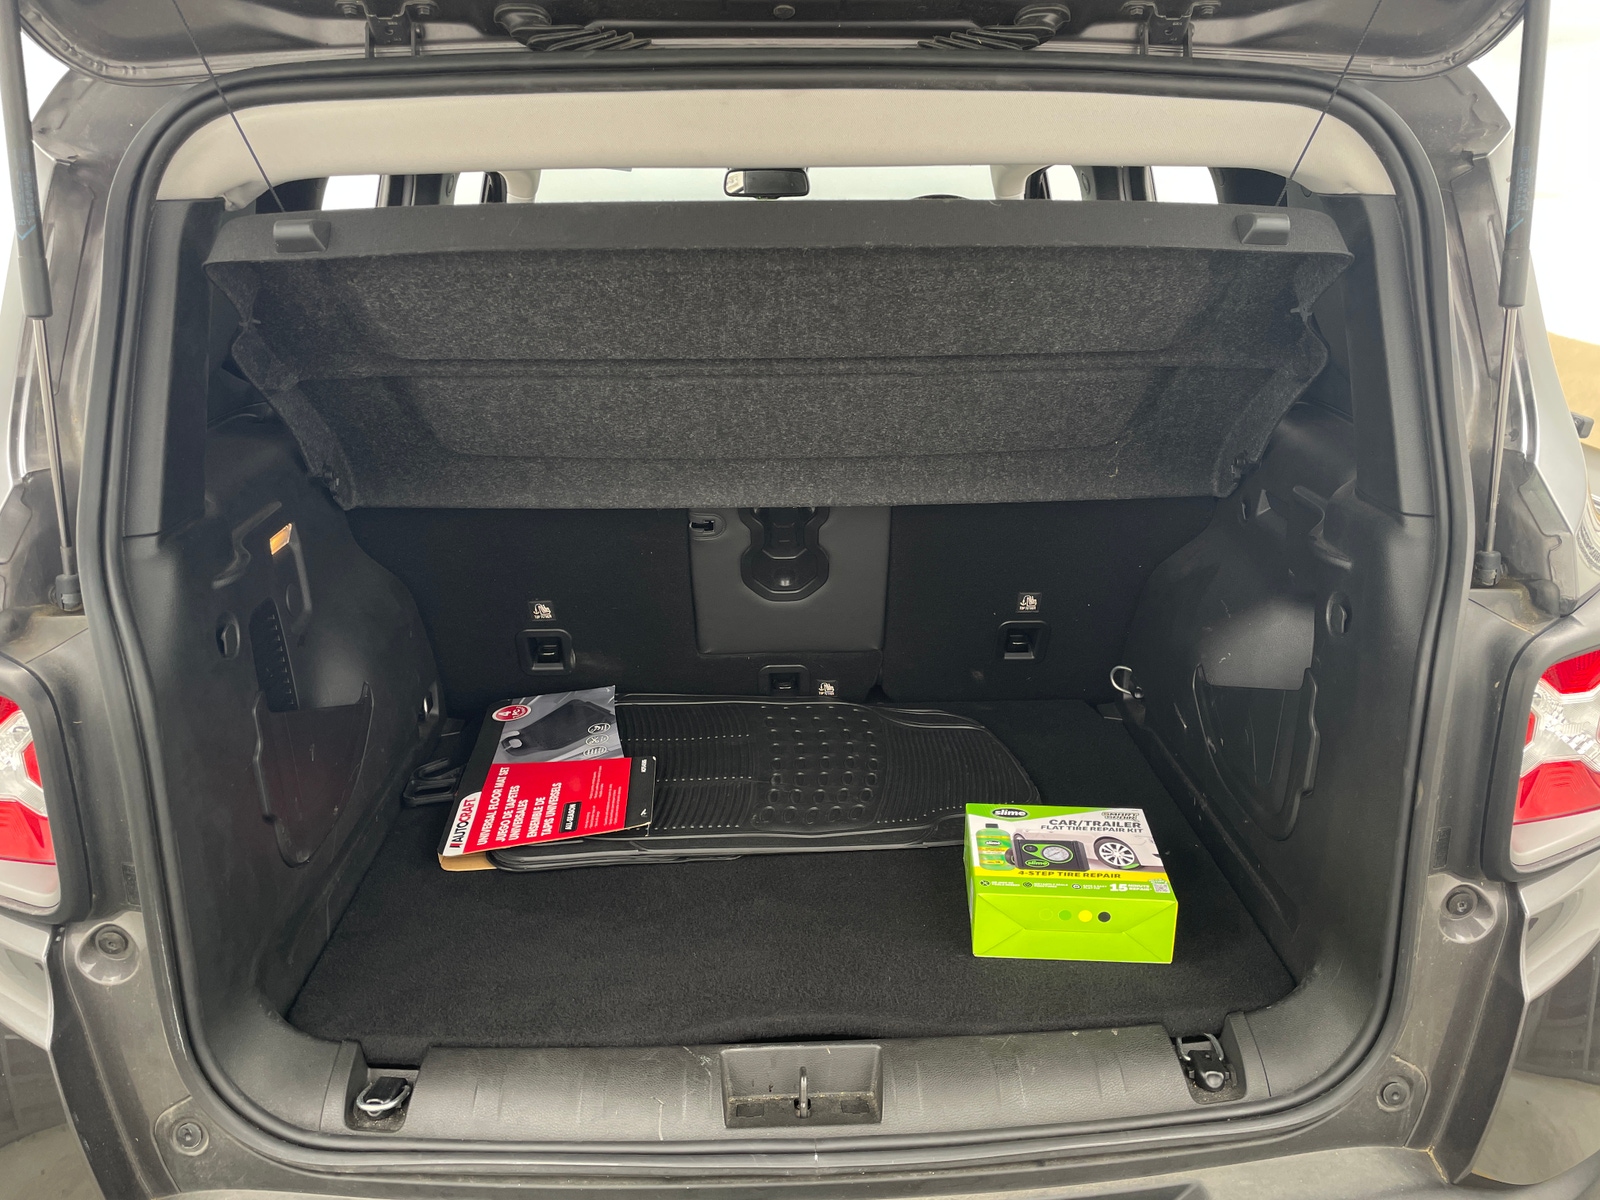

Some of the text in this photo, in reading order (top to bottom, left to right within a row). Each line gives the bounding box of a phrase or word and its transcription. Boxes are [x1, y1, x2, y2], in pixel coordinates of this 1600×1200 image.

[451, 798, 477, 843] AUTOCRAFT
[477, 767, 510, 846] UNIVERSAL FLOOR MAT SET
[495, 785, 521, 842] JUEGO DE TAPETES
[508, 799, 529, 841] UNIVERSALES
[526, 797, 546, 838] ENSEMBLE DE
[541, 782, 562, 836] TAPIS UNIVERSELS
[565, 803, 577, 830] ALL-SEASON
[994, 809, 1027, 817] slime
[1049, 819, 1141, 828] CAR/TRAILER
[1110, 883, 1128, 892] 15
